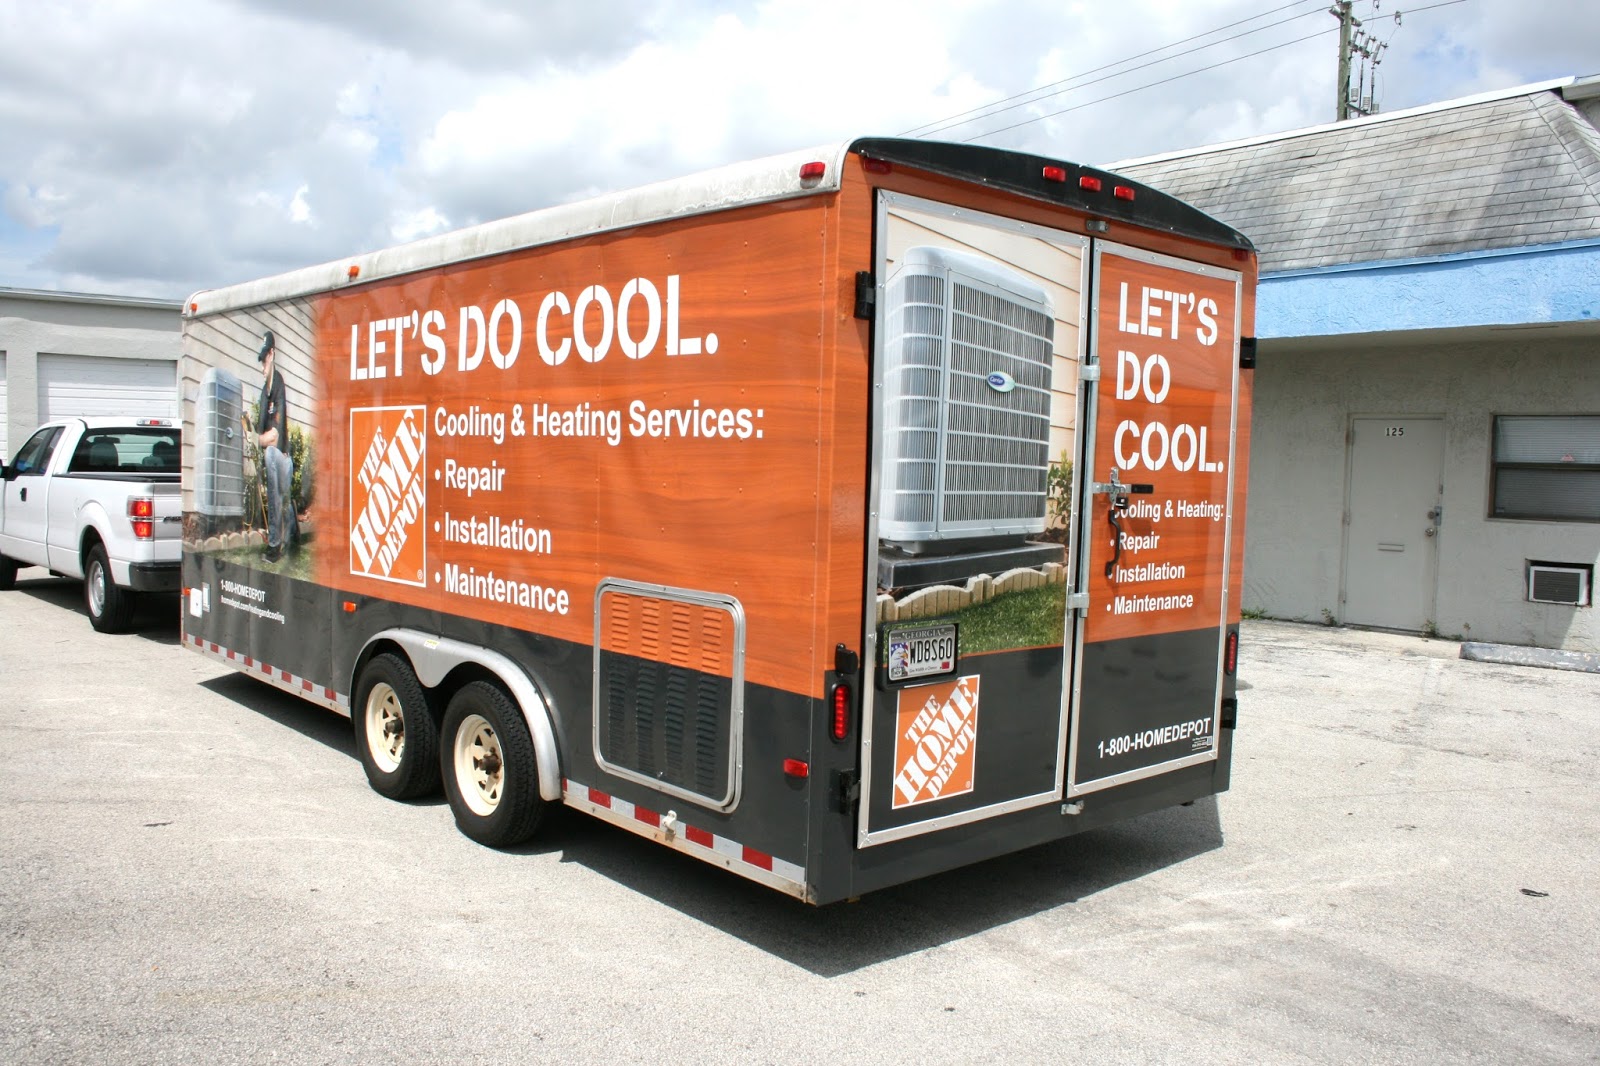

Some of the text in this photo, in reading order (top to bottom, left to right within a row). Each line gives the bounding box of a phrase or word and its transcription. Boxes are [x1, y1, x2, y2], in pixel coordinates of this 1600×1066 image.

[350, 274, 719, 381] LET'S DO COOL.
[1119, 281, 1218, 346] LET'S
[1116, 350, 1171, 404] DO
[434, 399, 765, 446] Cooling & Heating Services:
[1114, 420, 1224, 473] COOL.
[1385, 427, 1404, 437] 125
[357, 425, 388, 493] THE
[445, 458, 506, 497] Repair
[351, 408, 425, 574] HOME
[1164, 500, 1174, 518] &
[1177, 500, 1224, 521] Heating:
[378, 472, 425, 578] DEPOT
[445, 512, 552, 554] Installation
[1119, 531, 1161, 554] Repair
[220, 579, 266, 603] 1-800-HOMEDEPOT
[445, 563, 570, 615] Maintenance
[1116, 562, 1186, 583] Installation
[1114, 594, 1194, 615] Maintenance
[904, 629, 941, 639] GEORGIA
[894, 678, 978, 804] HOME
[905, 694, 941, 746] THE
[1098, 717, 1211, 759] 1-800-HOMEDEPOT
[926, 720, 975, 799] DEPOT
